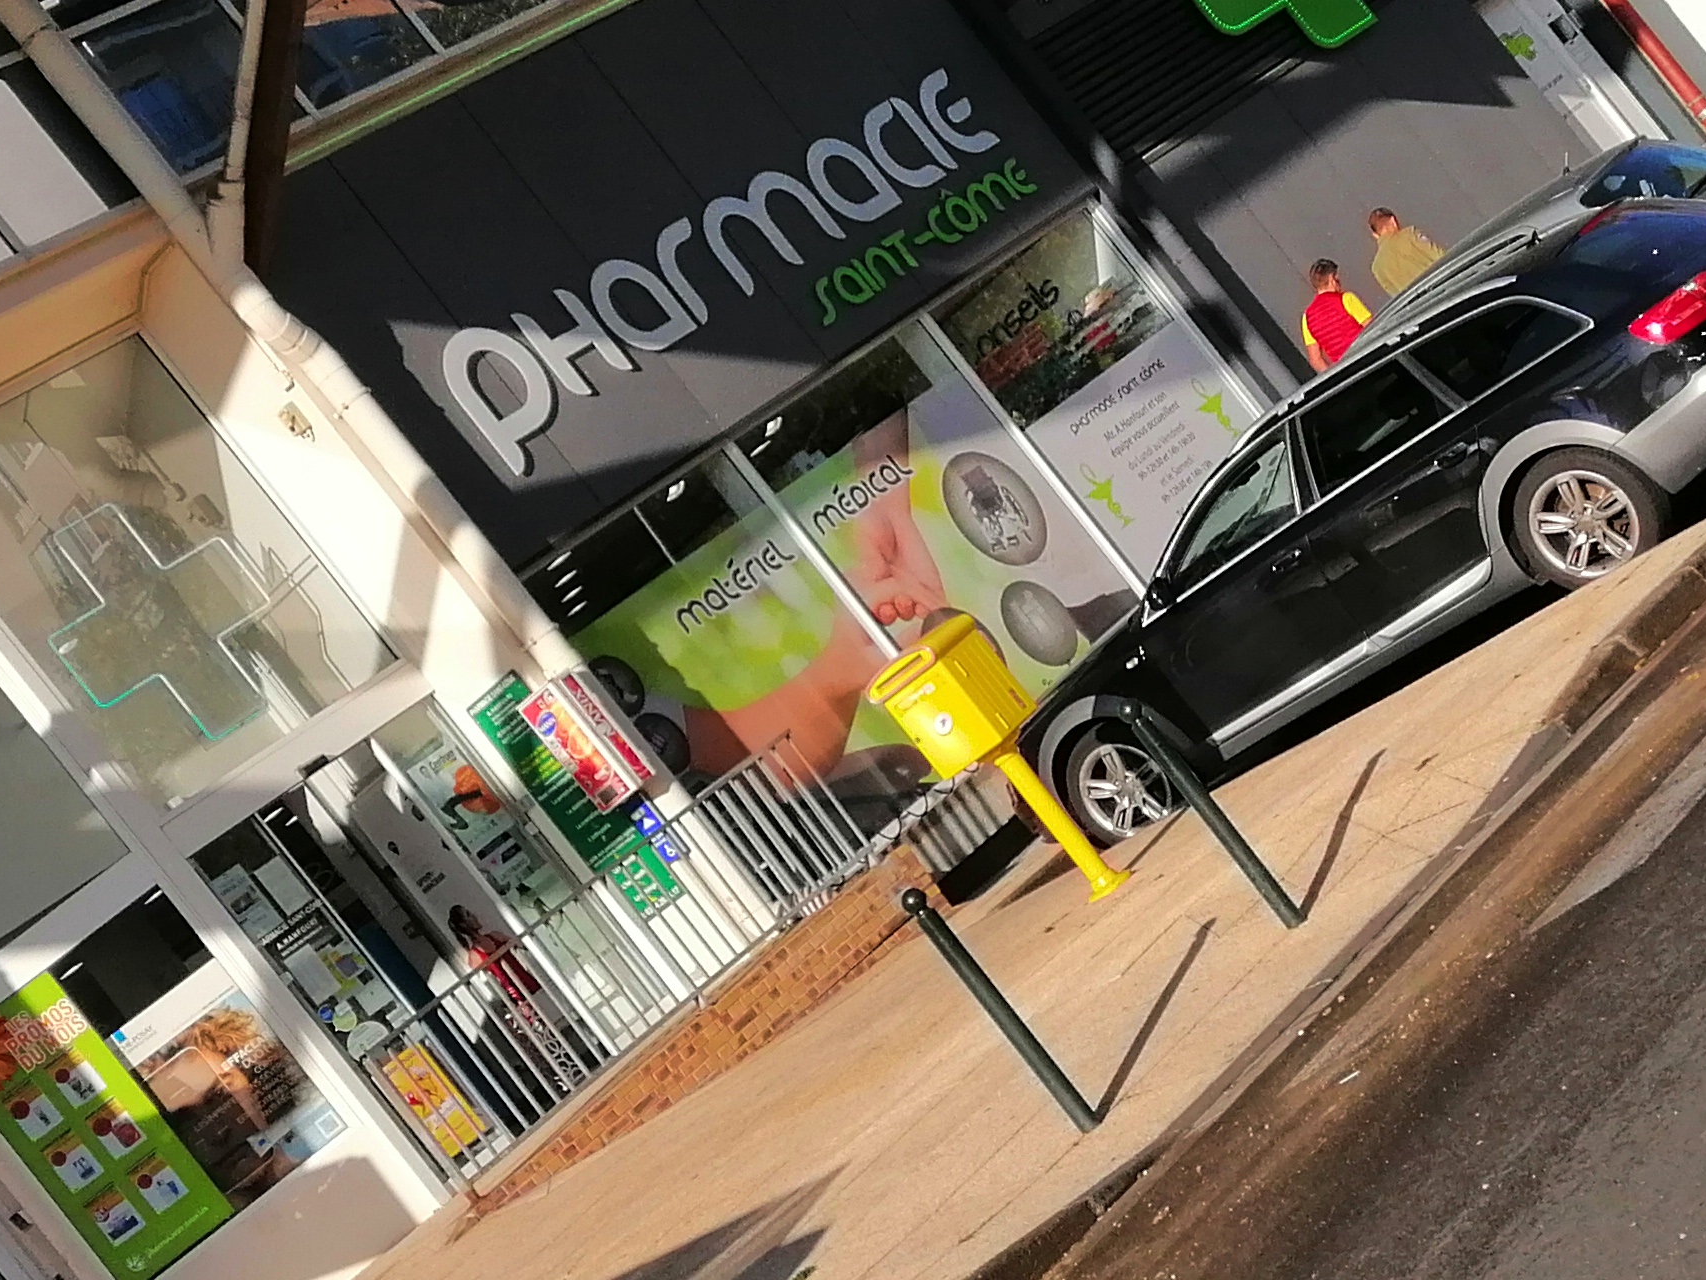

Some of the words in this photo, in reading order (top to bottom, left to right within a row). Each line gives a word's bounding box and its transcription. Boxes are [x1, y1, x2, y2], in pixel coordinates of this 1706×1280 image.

[973, 276, 1061, 362] onseils
[1153, 390, 1168, 405] son
[1108, 434, 1135, 458] équipe
[1131, 425, 1149, 441] vous
[1144, 399, 1180, 430] accueillent
[259, 921, 289, 946] ARMACIE
[3, 996, 76, 1056] PROMOS
[4, 1009, 31, 1034] LES
[16, 1042, 48, 1072] DU
[40, 1012, 88, 1054] MOIS
